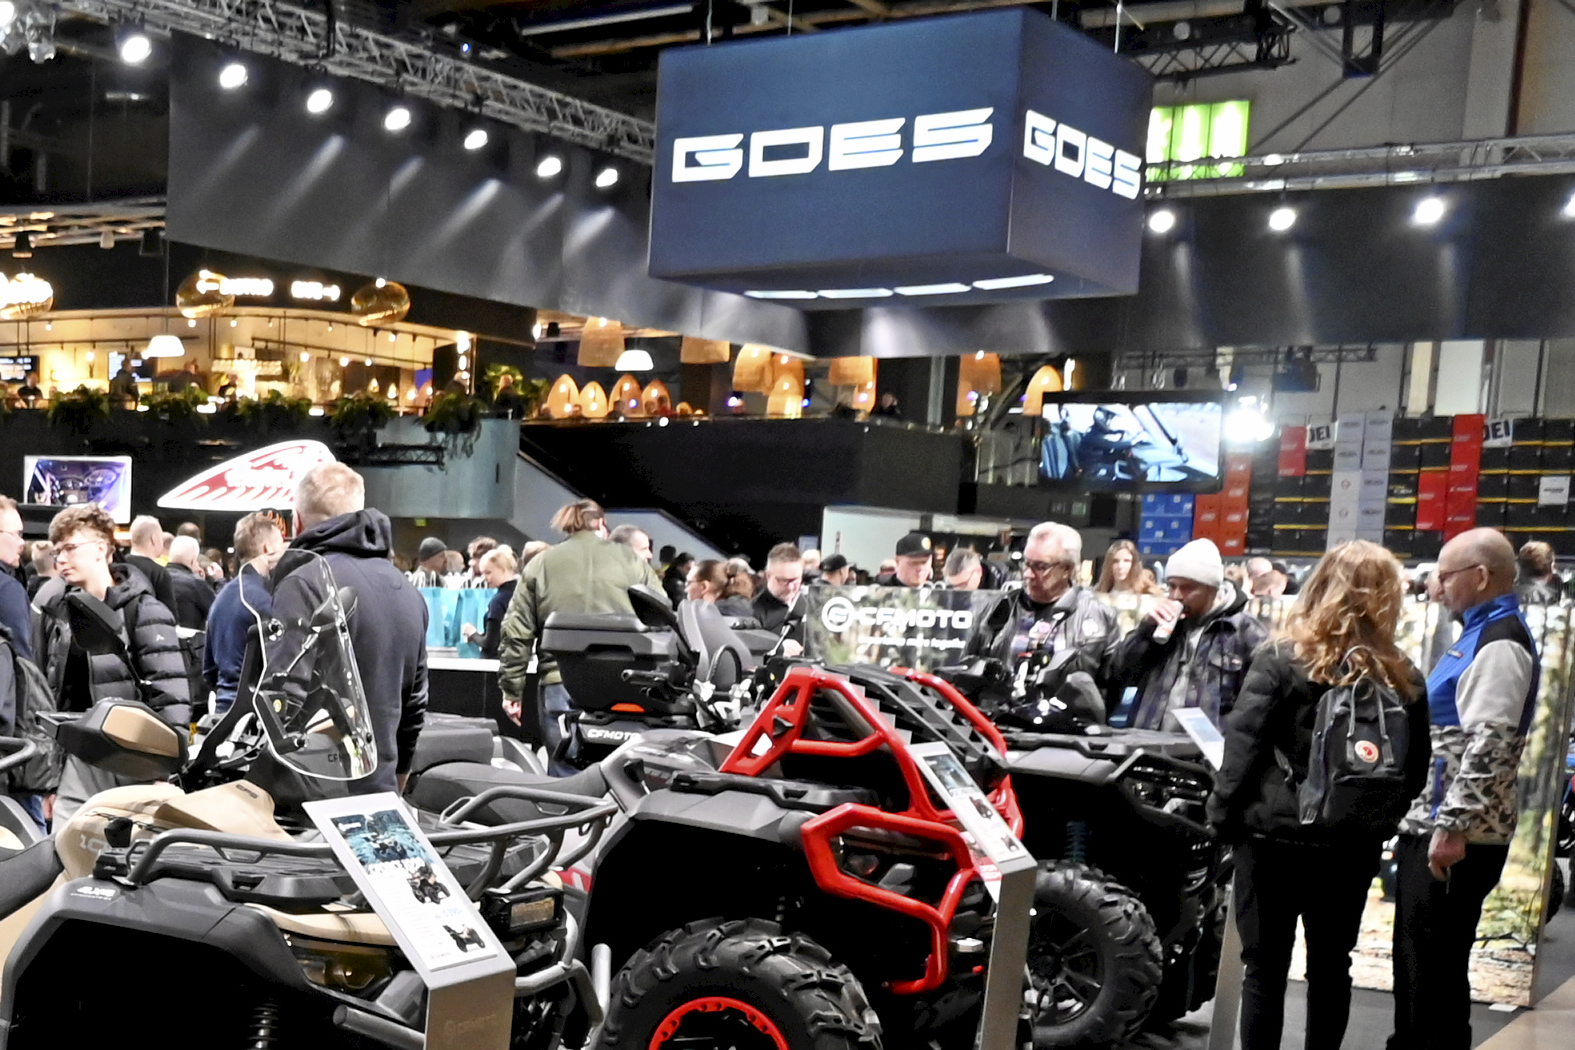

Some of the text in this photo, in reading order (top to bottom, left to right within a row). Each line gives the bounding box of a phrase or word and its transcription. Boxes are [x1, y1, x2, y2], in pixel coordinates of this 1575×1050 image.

[671, 106, 995, 184] GOES
[1023, 109, 1142, 201] GOES
[858, 606, 973, 629] CFMOTO
[586, 728, 642, 741] CFMOTO
